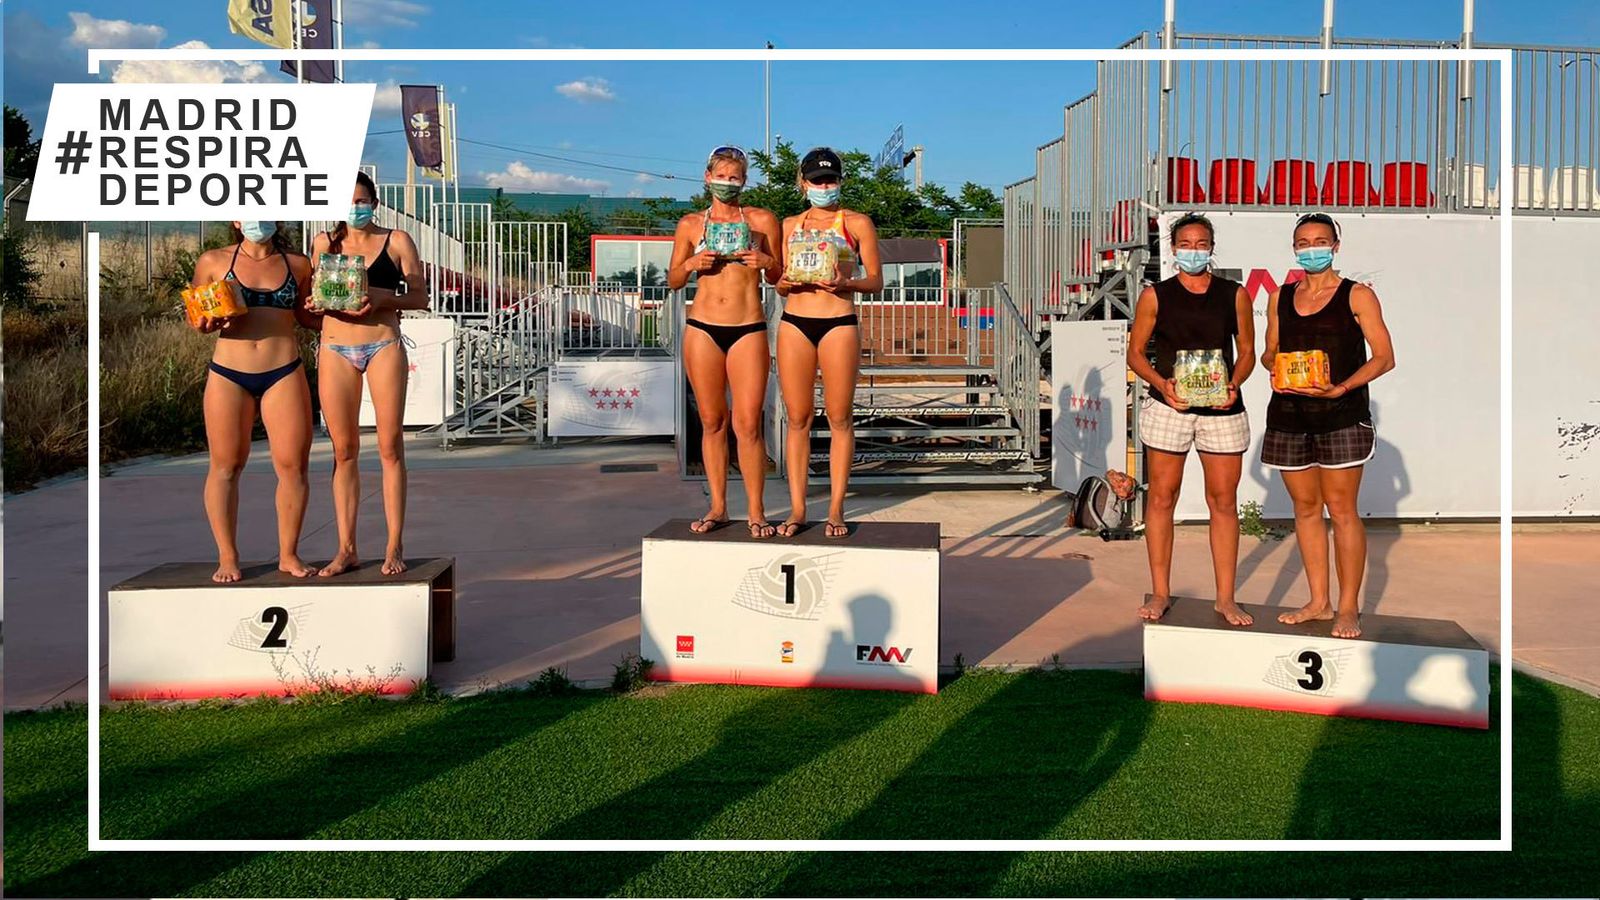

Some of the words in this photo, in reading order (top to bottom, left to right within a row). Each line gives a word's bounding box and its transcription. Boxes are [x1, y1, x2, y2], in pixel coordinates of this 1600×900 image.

[781, 564, 796, 604] 1
[260, 606, 289, 649] 2
[1297, 650, 1324, 691] 3
